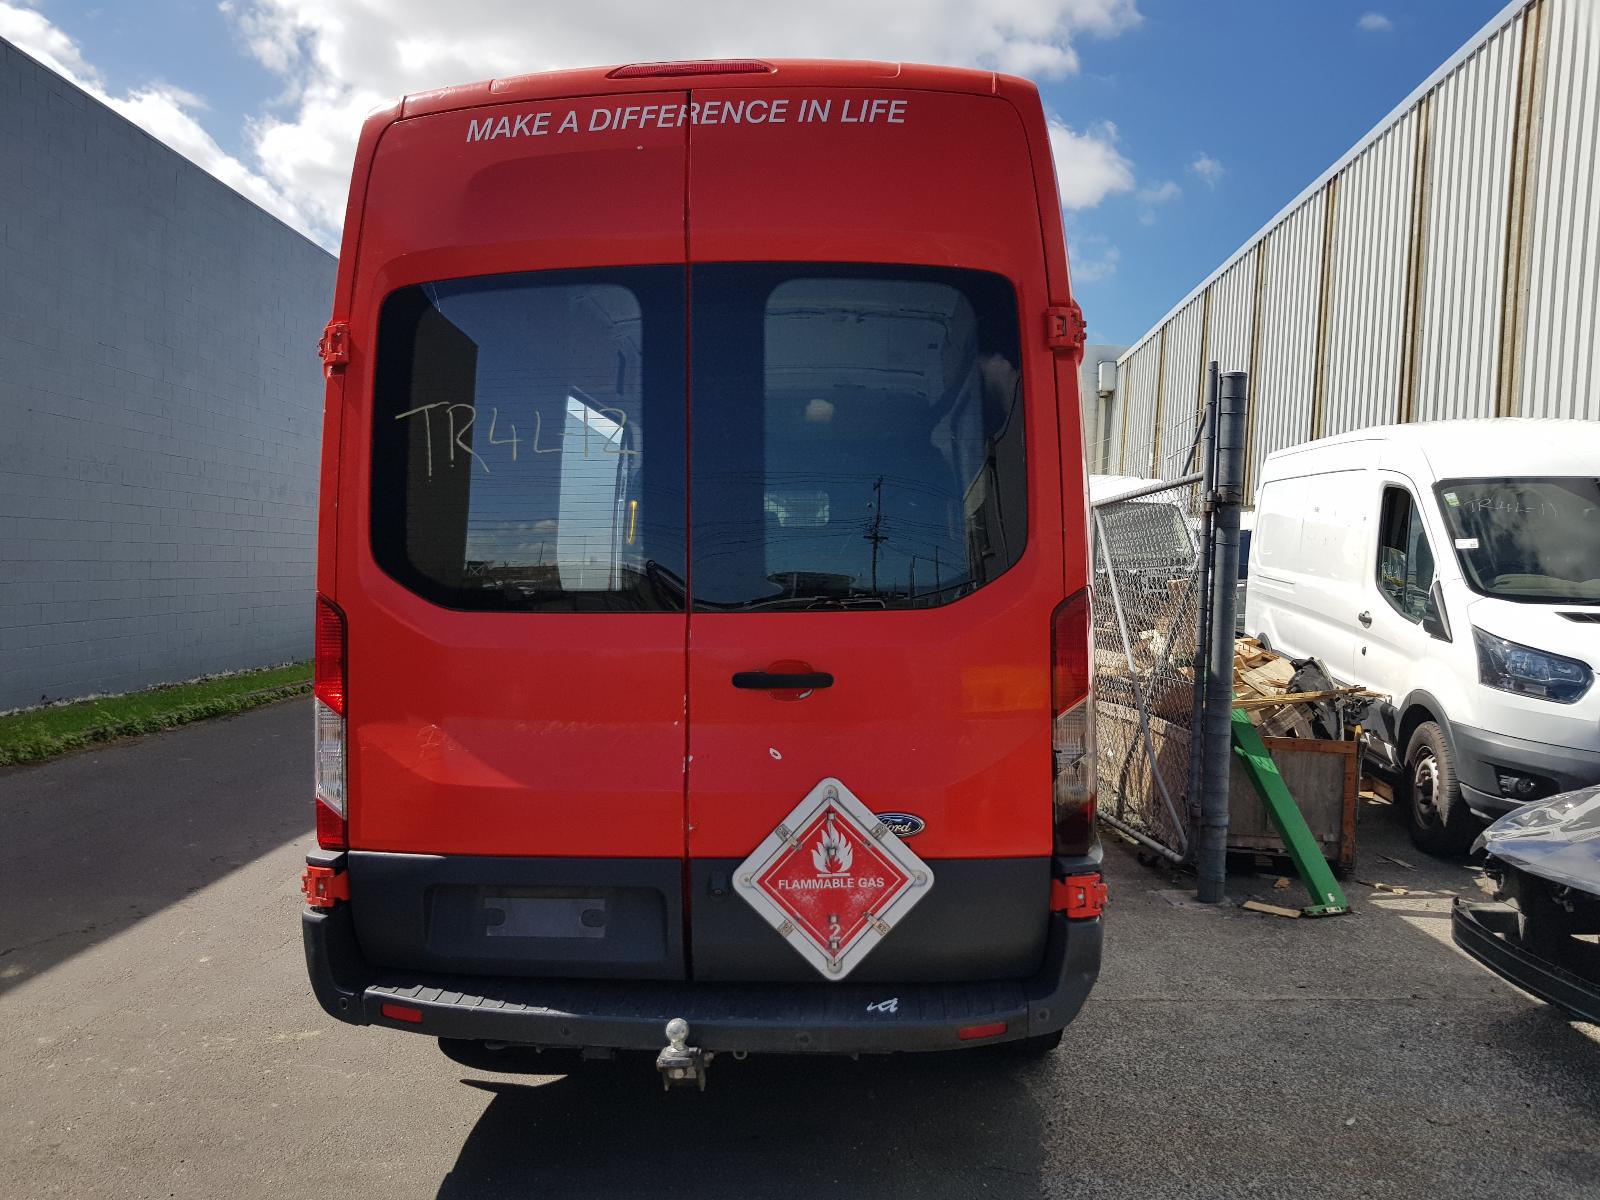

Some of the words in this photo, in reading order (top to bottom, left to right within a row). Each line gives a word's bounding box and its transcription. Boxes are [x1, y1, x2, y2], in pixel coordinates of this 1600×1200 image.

[466, 112, 551, 142] MAKE
[558, 110, 579, 134] A
[588, 99, 789, 132] DIFFERENCE
[797, 99, 830, 123] IN
[841, 99, 908, 124] LIFE
[778, 877, 855, 890] FLAMMABLE
[858, 877, 885, 889] GAS
[829, 923, 840, 941] 2
